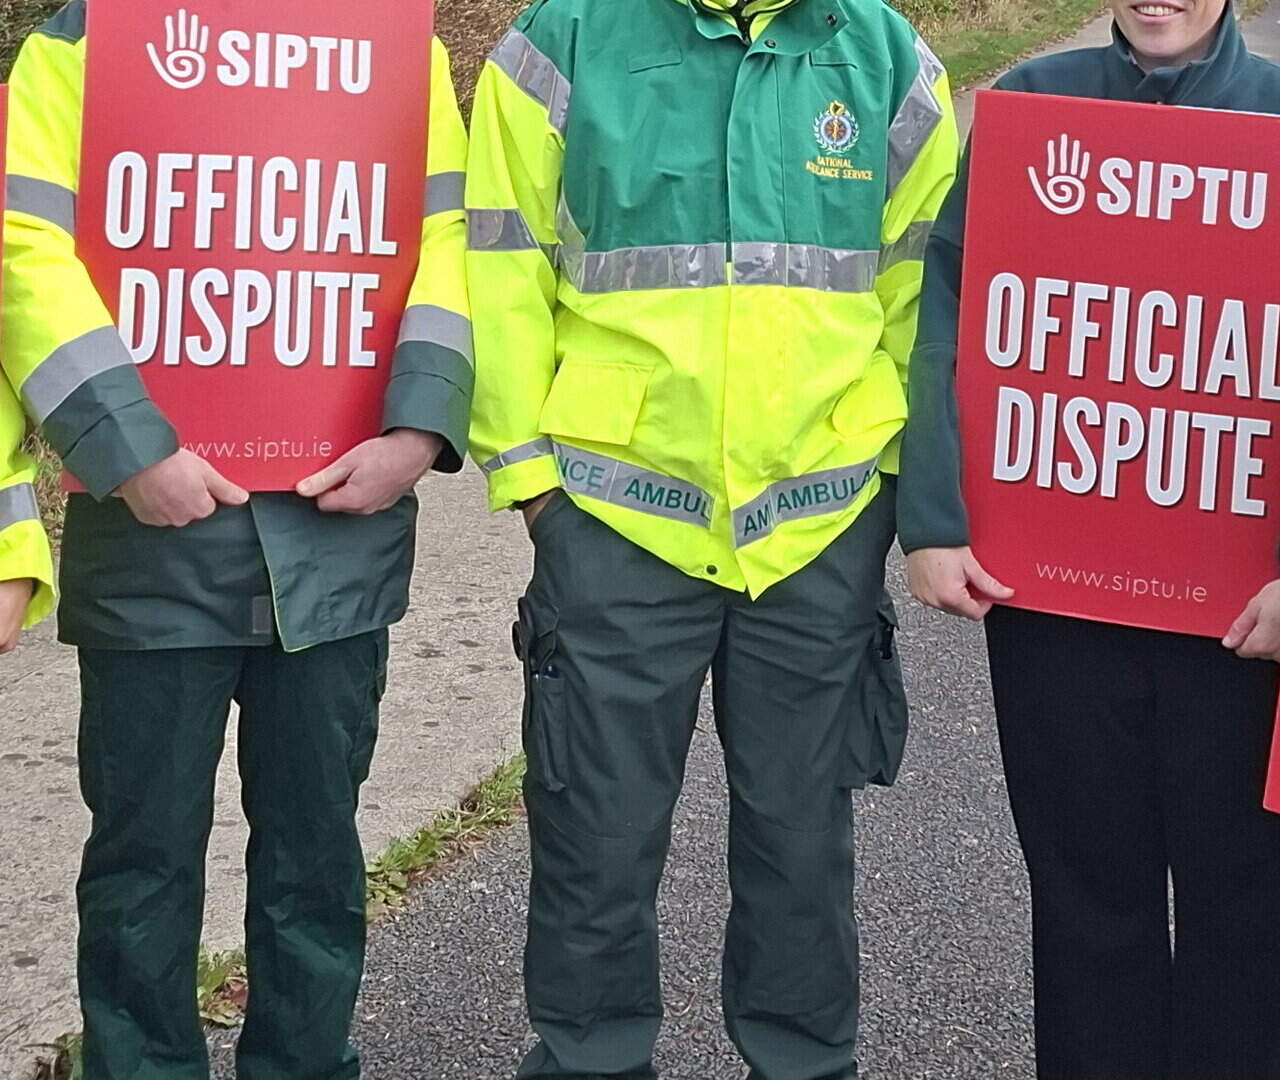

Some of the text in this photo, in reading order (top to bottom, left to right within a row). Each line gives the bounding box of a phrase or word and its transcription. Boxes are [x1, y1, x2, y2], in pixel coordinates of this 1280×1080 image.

[216, 30, 372, 94] SIPTU
[105, 151, 397, 255] OFFICIAL
[1096, 157, 1267, 229] SIPTU
[119, 267, 380, 367] DISPUTE
[183, 436, 332, 462] ww.siptu.ie
[993, 387, 1272, 516] DISPUTE
[1036, 562, 1207, 603] www.siptu.ie
